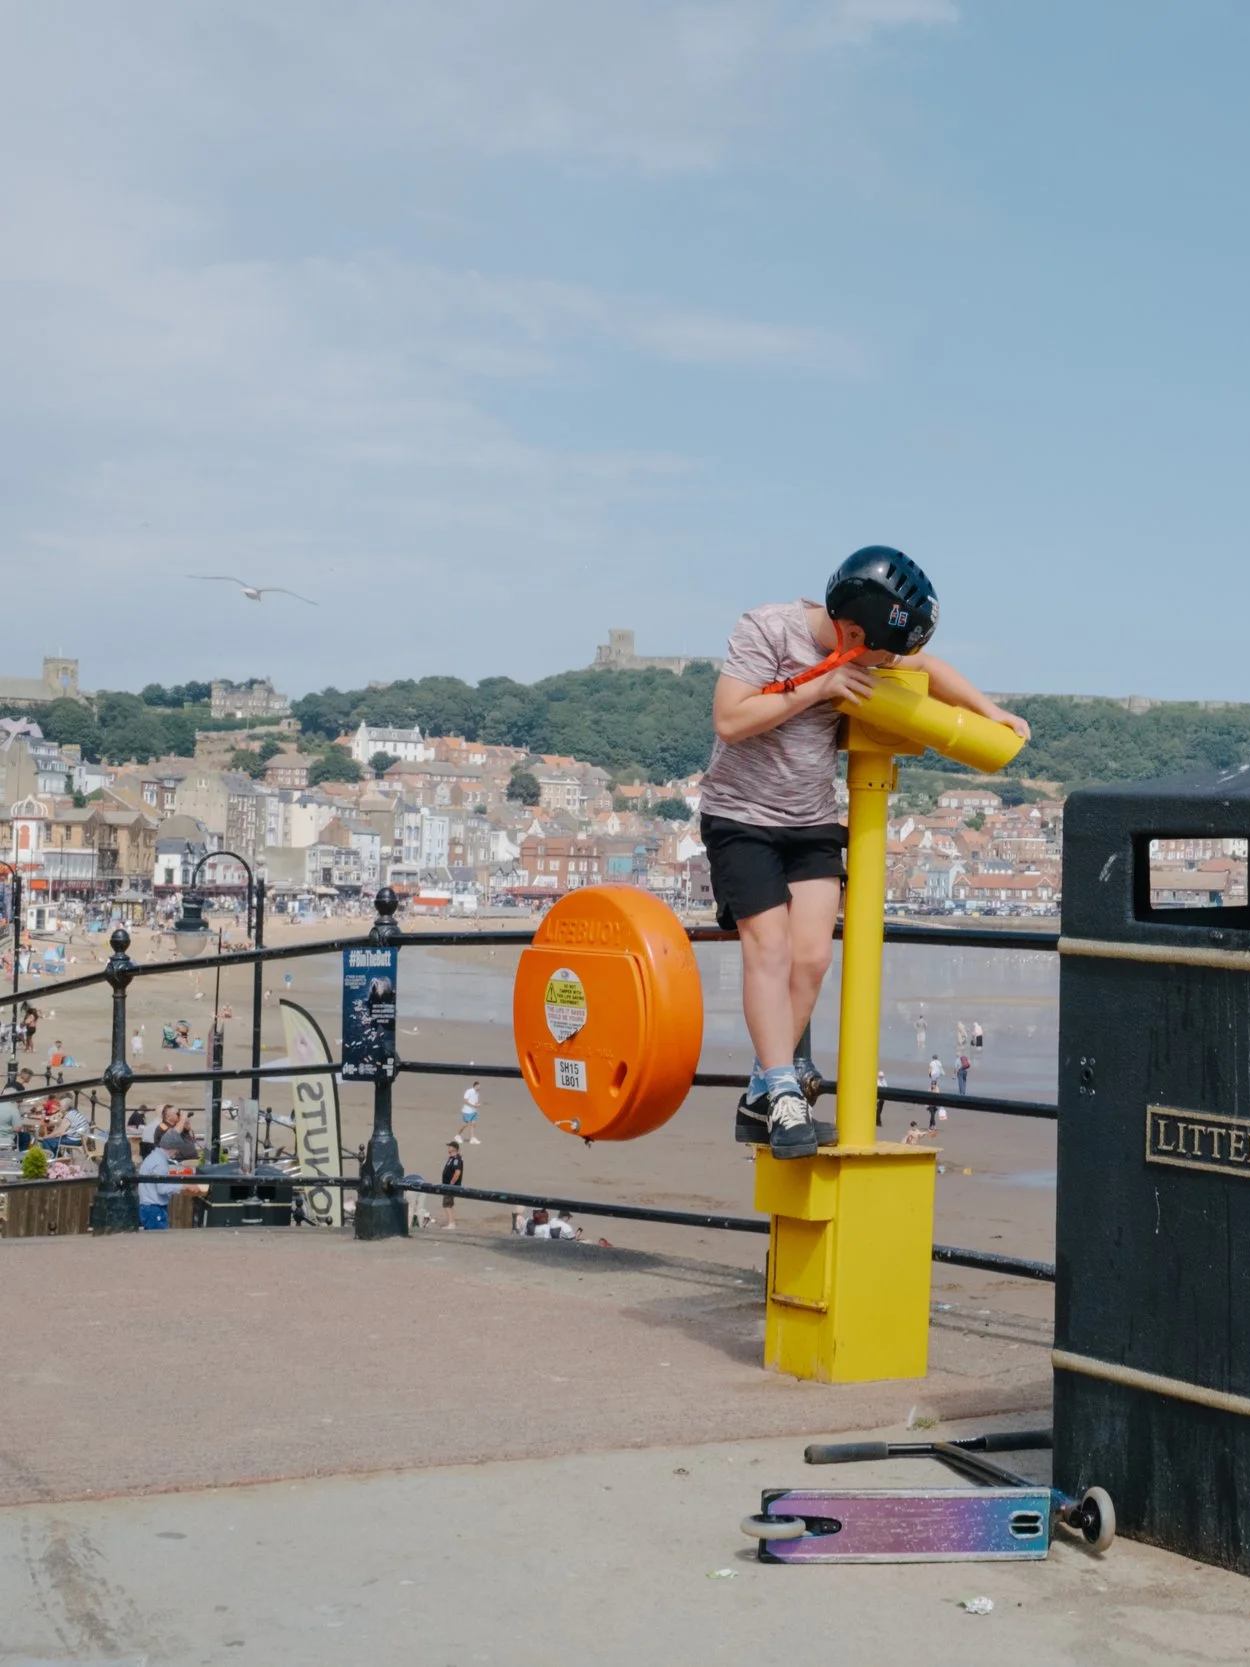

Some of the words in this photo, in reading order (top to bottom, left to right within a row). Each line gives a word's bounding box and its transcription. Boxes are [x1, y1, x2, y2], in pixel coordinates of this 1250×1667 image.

[544, 917, 620, 946] LIFEBUOY
[559, 1061, 579, 1075] SH15
[561, 1074, 579, 1088] LB01
